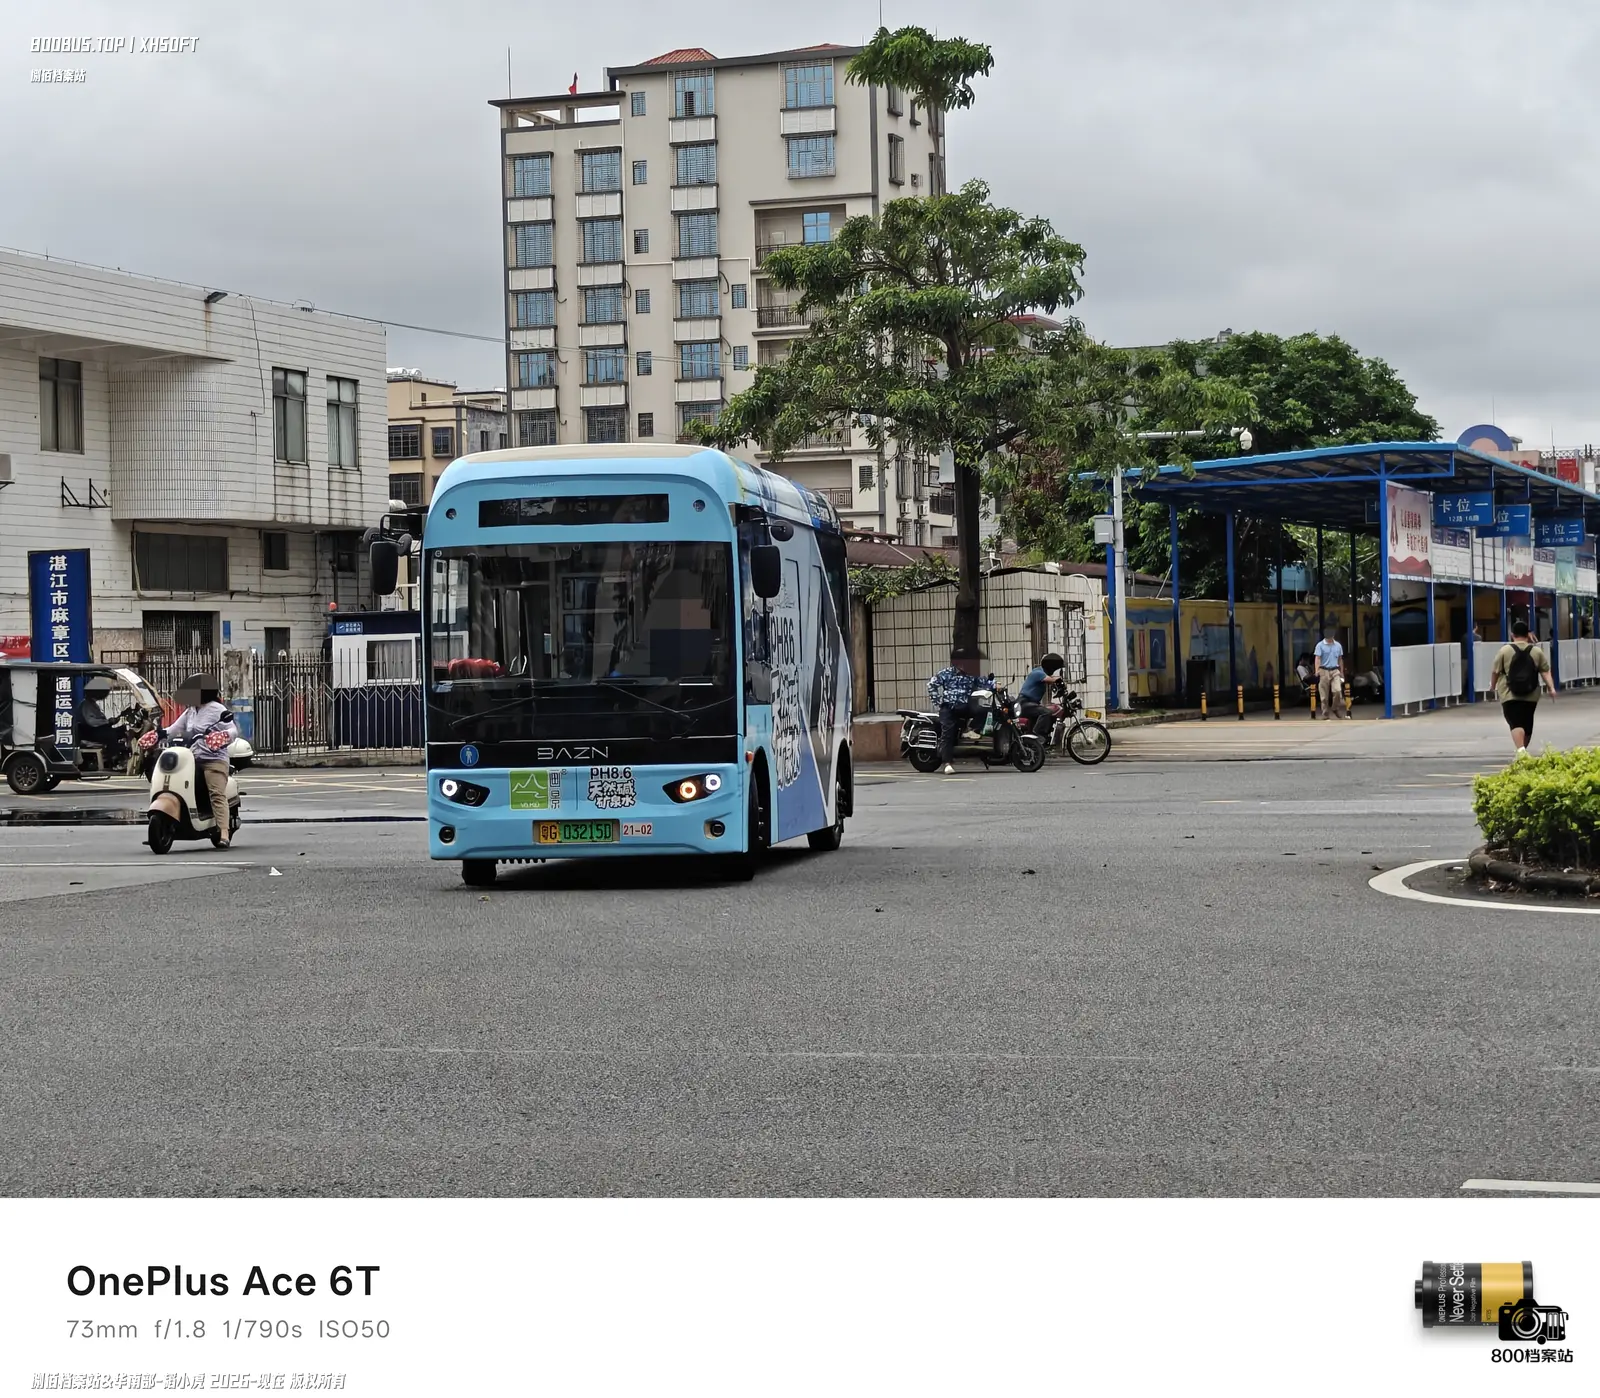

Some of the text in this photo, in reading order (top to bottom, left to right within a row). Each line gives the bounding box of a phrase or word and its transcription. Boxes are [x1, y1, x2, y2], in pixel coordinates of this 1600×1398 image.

[1438, 498, 1489, 513] 卡位一
[1496, 510, 1526, 523] 位一
[1538, 523, 1580, 536] 卡位二
[49, 555, 74, 746] 湛江市麻章区通运输局
[537, 746, 609, 760] BAZN
[590, 766, 632, 780] PH8.6
[587, 780, 637, 801] 天然碱
[595, 794, 637, 810] 矿泉水
[541, 824, 558, 841] 粤G
[623, 824, 653, 836] 21-02
